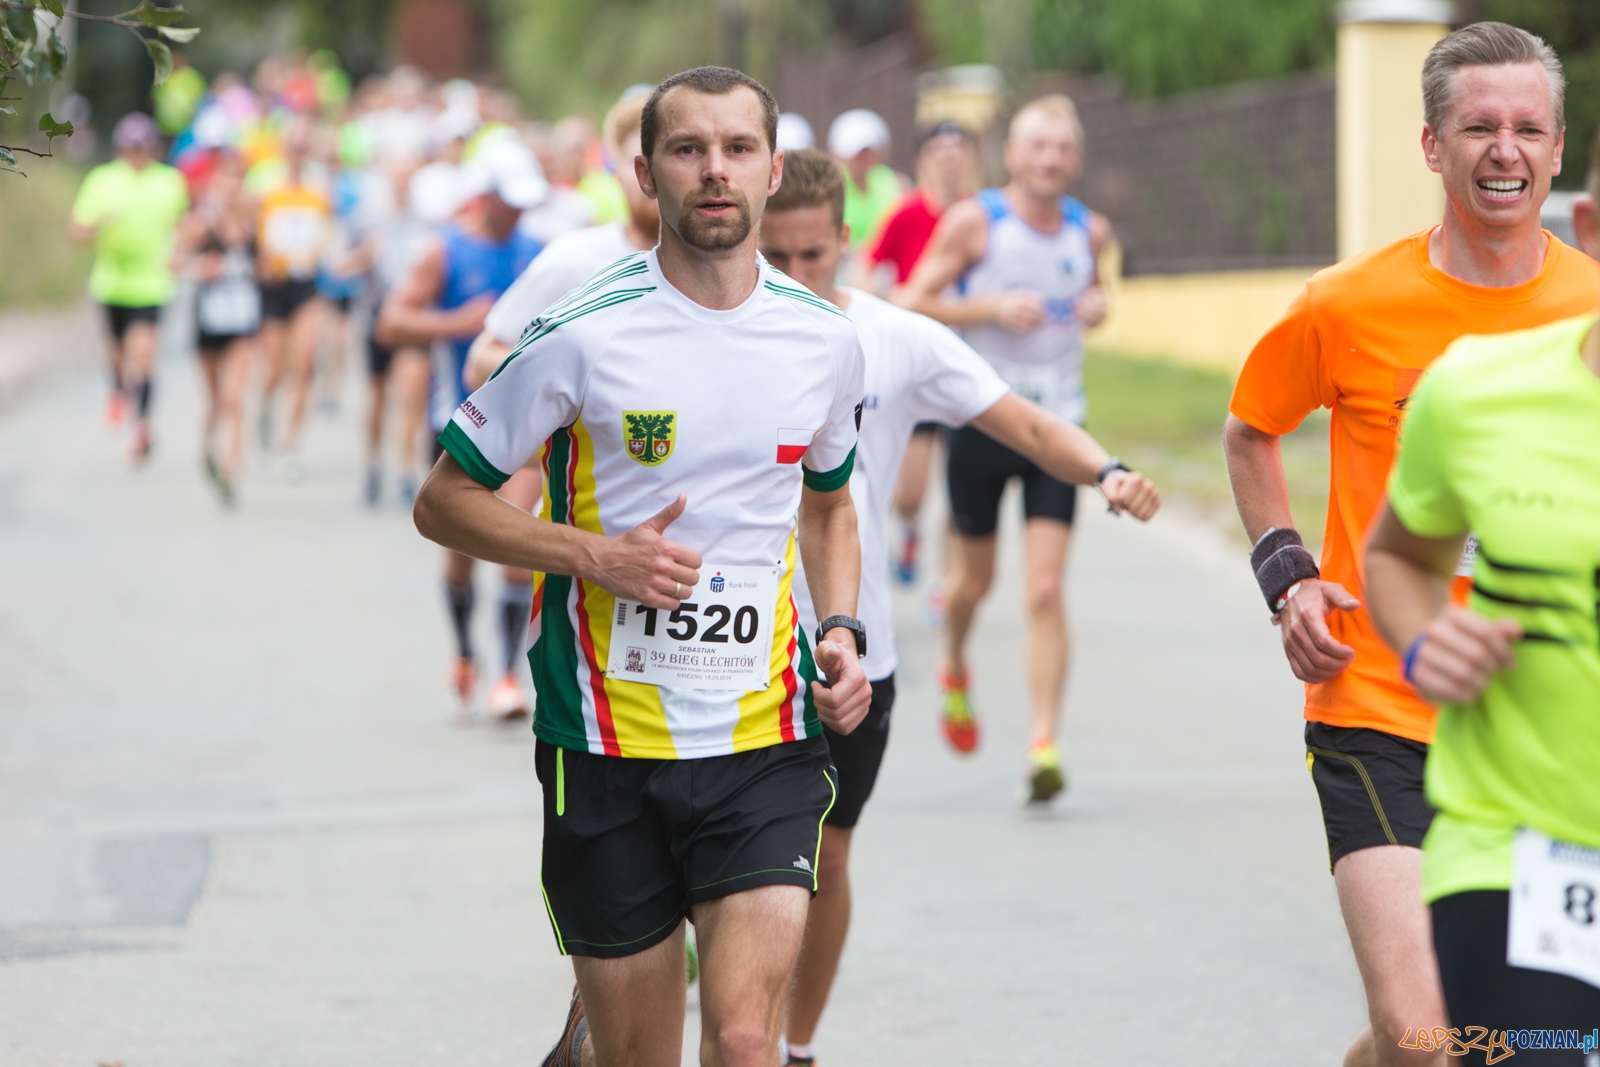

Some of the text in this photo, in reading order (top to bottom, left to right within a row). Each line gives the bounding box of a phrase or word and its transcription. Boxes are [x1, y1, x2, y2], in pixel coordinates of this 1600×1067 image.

[728, 581, 742, 589] Bank
[743, 581, 758, 589] Polski
[635, 602, 759, 645] 1520
[678, 645, 716, 654] SEBASTIAN
[650, 650, 757, 667] 39 BIEG LECHITÓW
